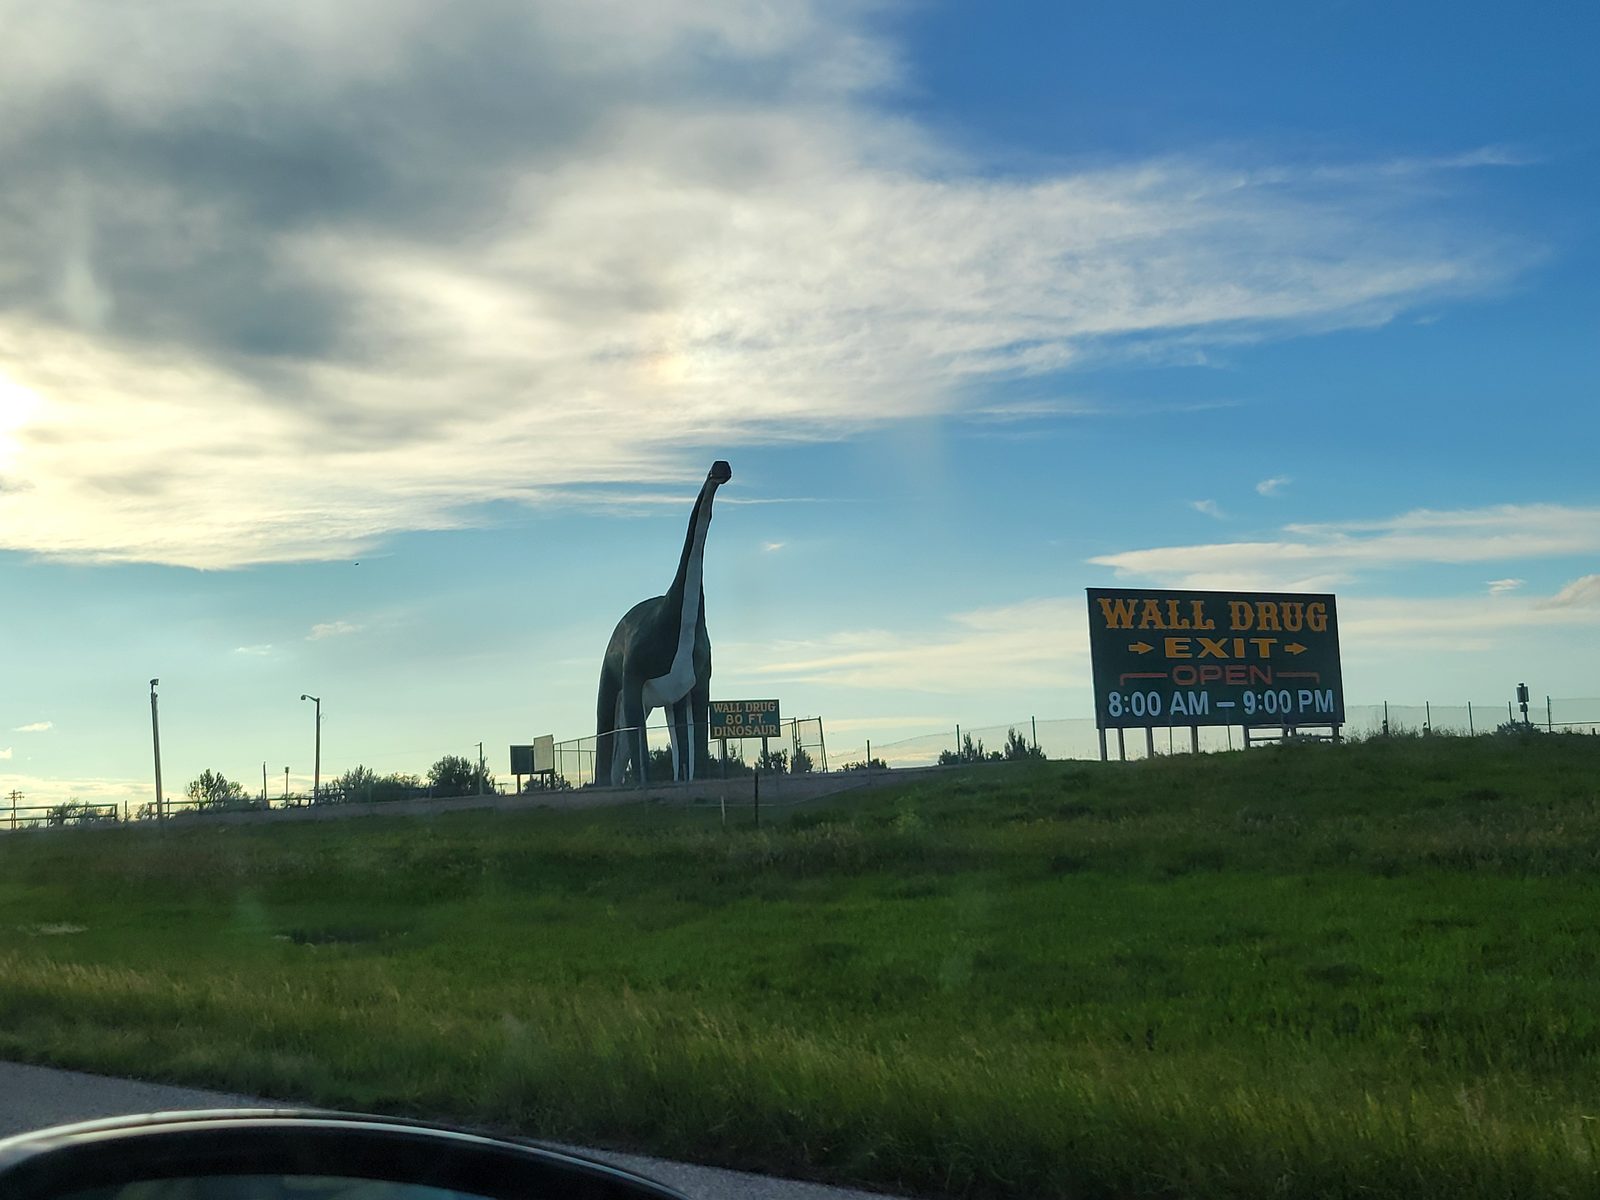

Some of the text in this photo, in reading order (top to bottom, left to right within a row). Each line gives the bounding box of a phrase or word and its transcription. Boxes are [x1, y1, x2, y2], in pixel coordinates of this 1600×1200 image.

[1097, 598, 1328, 632] WALL DRUG
[1165, 637, 1278, 659] EXIT
[1172, 664, 1273, 686] OPEN
[713, 701, 776, 713] WALL DRUG
[1108, 691, 1161, 717] 8:00
[1169, 691, 1209, 715] AM
[1242, 689, 1292, 715] 9:00
[1297, 689, 1334, 713] PM
[725, 713, 766, 725] 80 FT.
[713, 725, 777, 737] DINOSAUR
